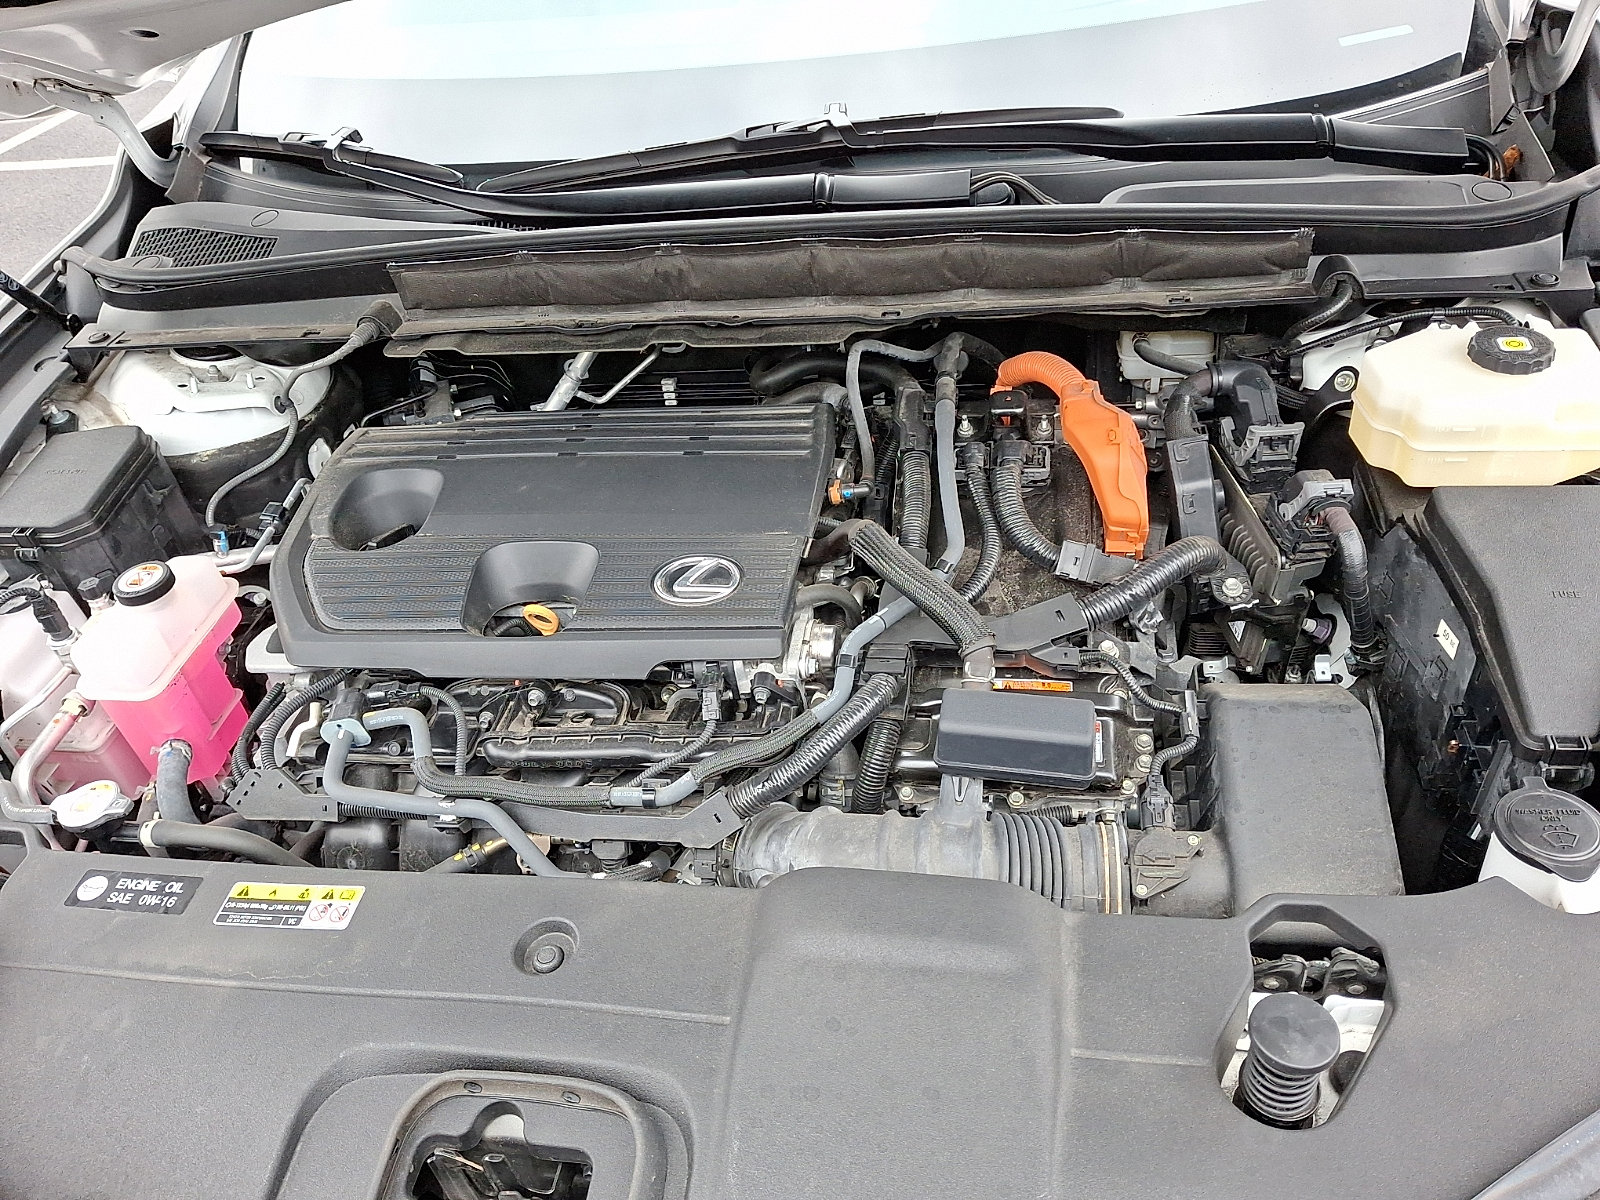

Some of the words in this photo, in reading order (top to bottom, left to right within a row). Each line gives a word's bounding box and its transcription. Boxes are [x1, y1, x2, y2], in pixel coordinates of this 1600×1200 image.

[1515, 808, 1553, 816] WASHER
[1556, 808, 1581, 816] FLUID
[115, 878, 161, 892] ENGINE
[164, 881, 184, 894] OIL
[106, 892, 135, 905] SAE
[138, 895, 178, 908] 0W-16
